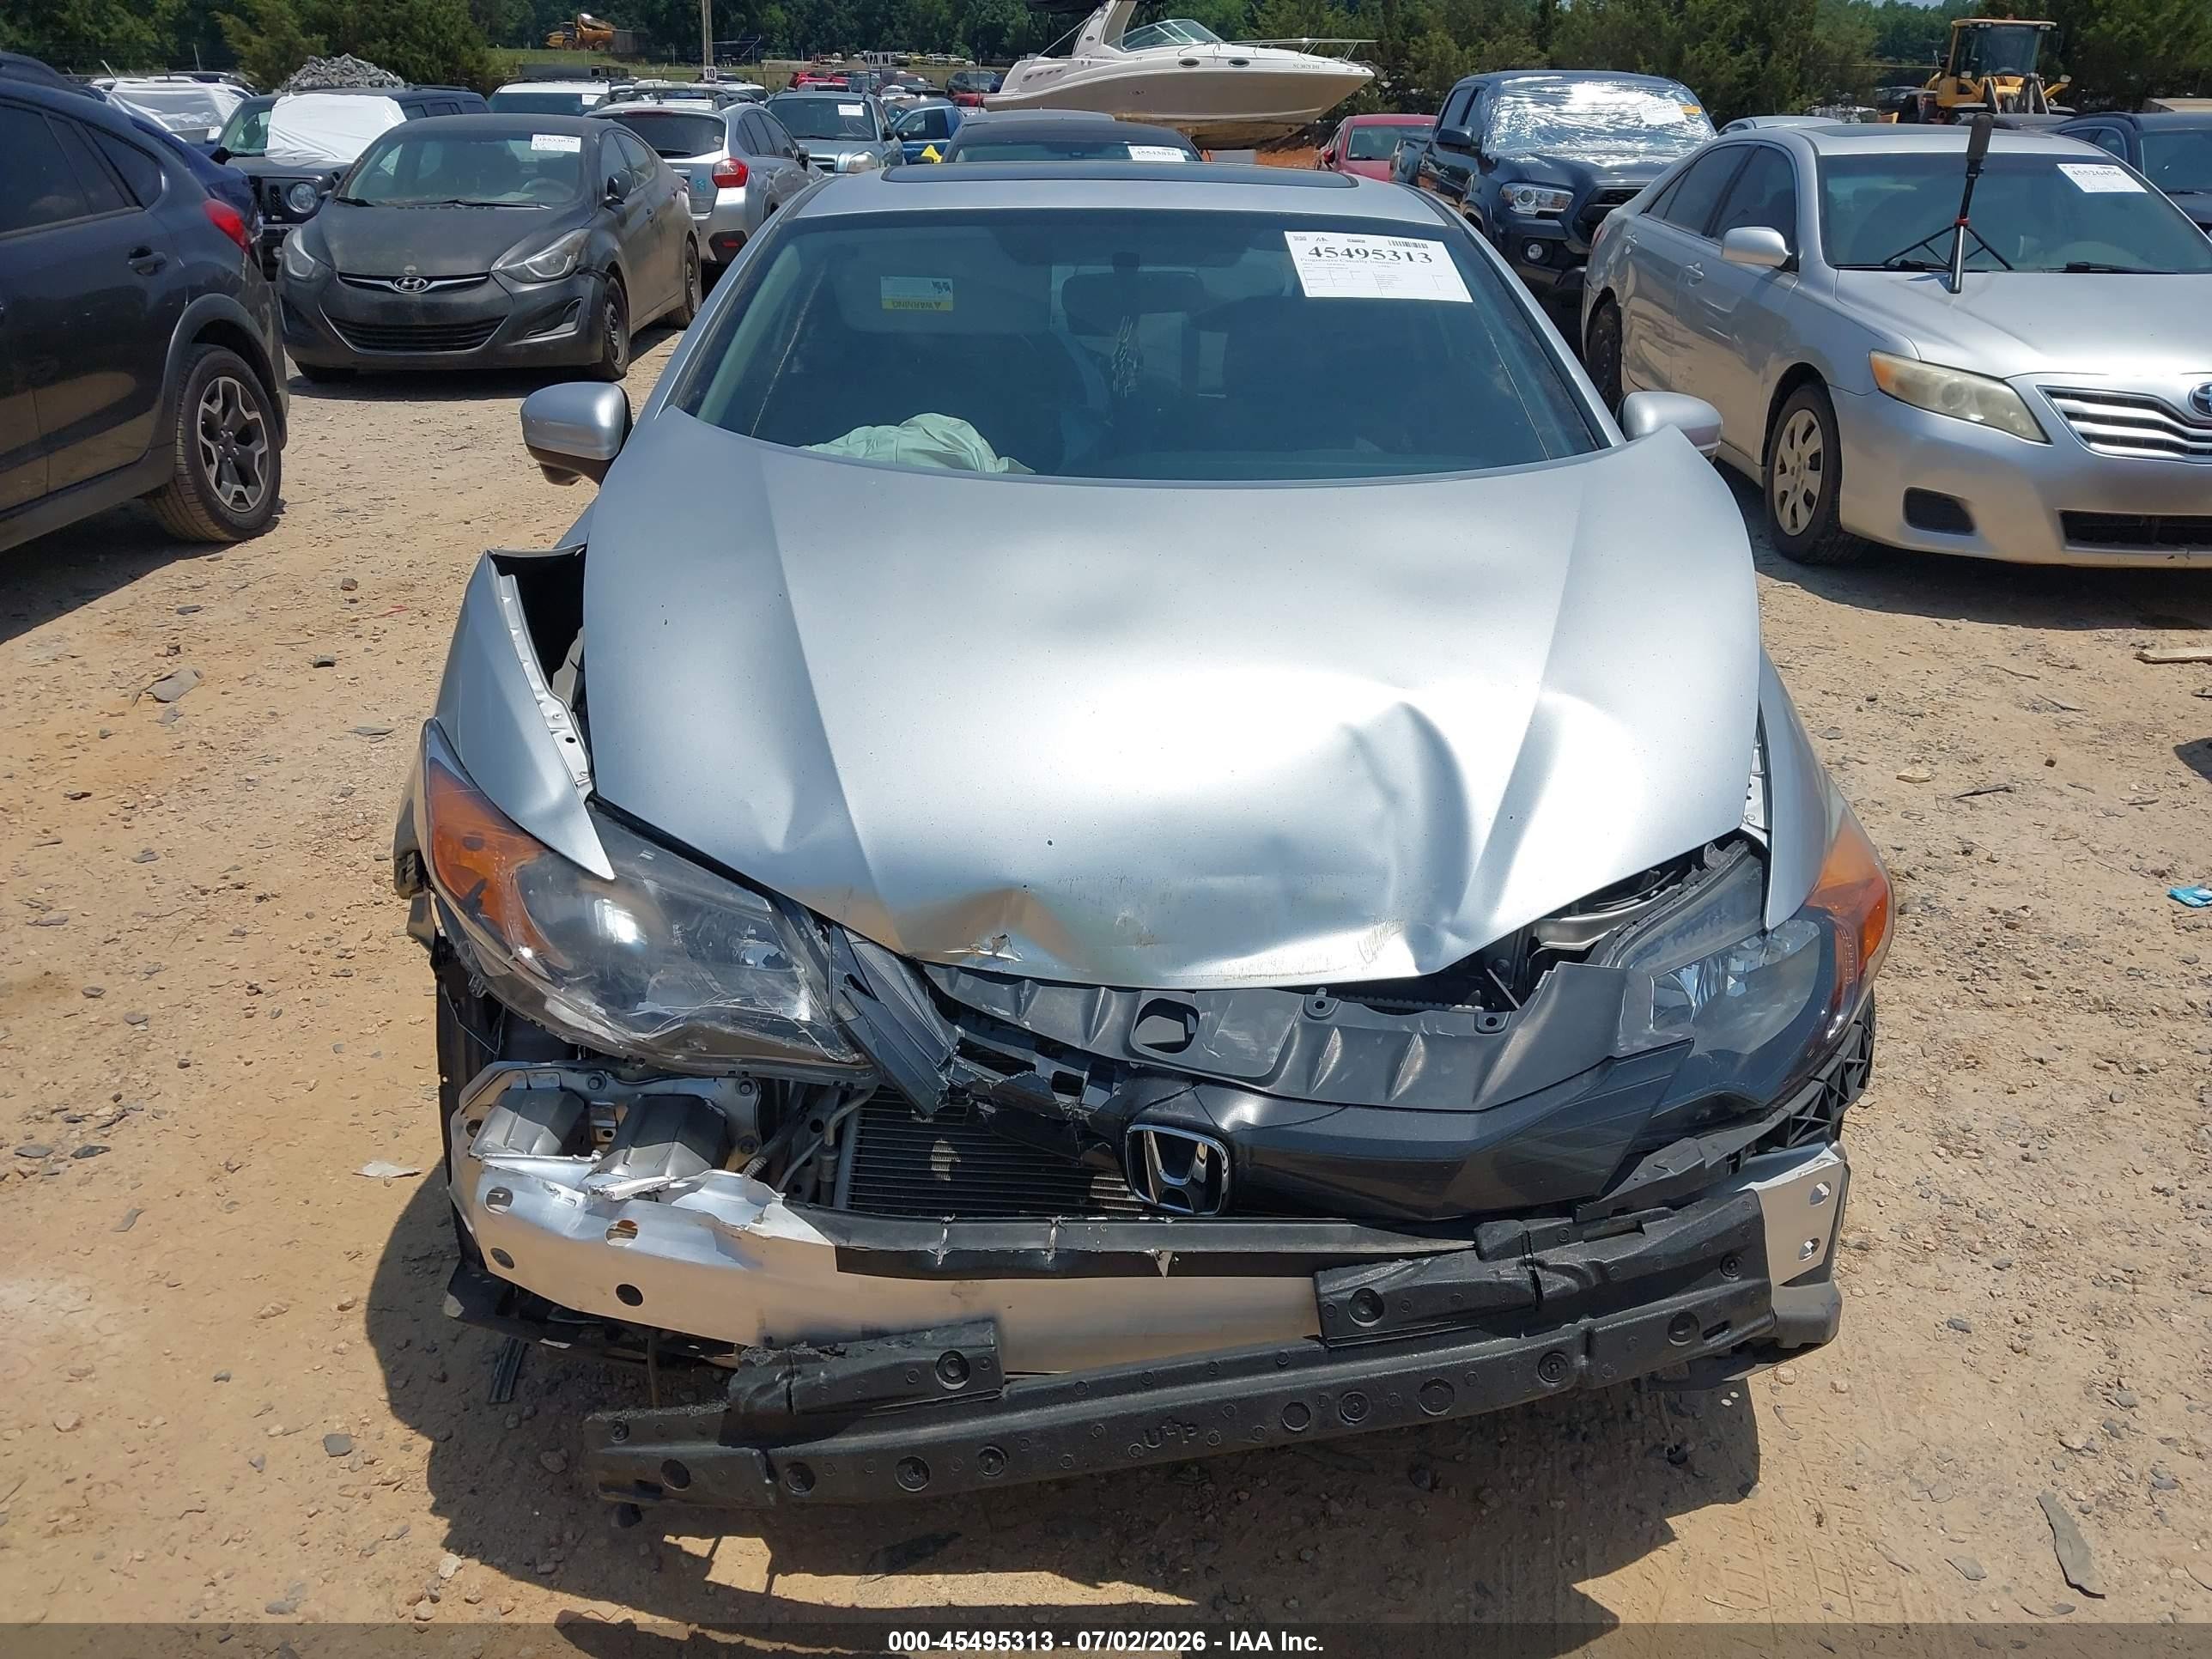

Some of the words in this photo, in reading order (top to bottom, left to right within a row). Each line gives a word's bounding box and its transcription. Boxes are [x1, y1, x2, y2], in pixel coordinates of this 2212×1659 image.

[882, 53, 889, 64] N
[705, 68, 715, 79] 10
[1308, 246, 1433, 264] 45495313
[892, 301, 935, 310] WARNING
